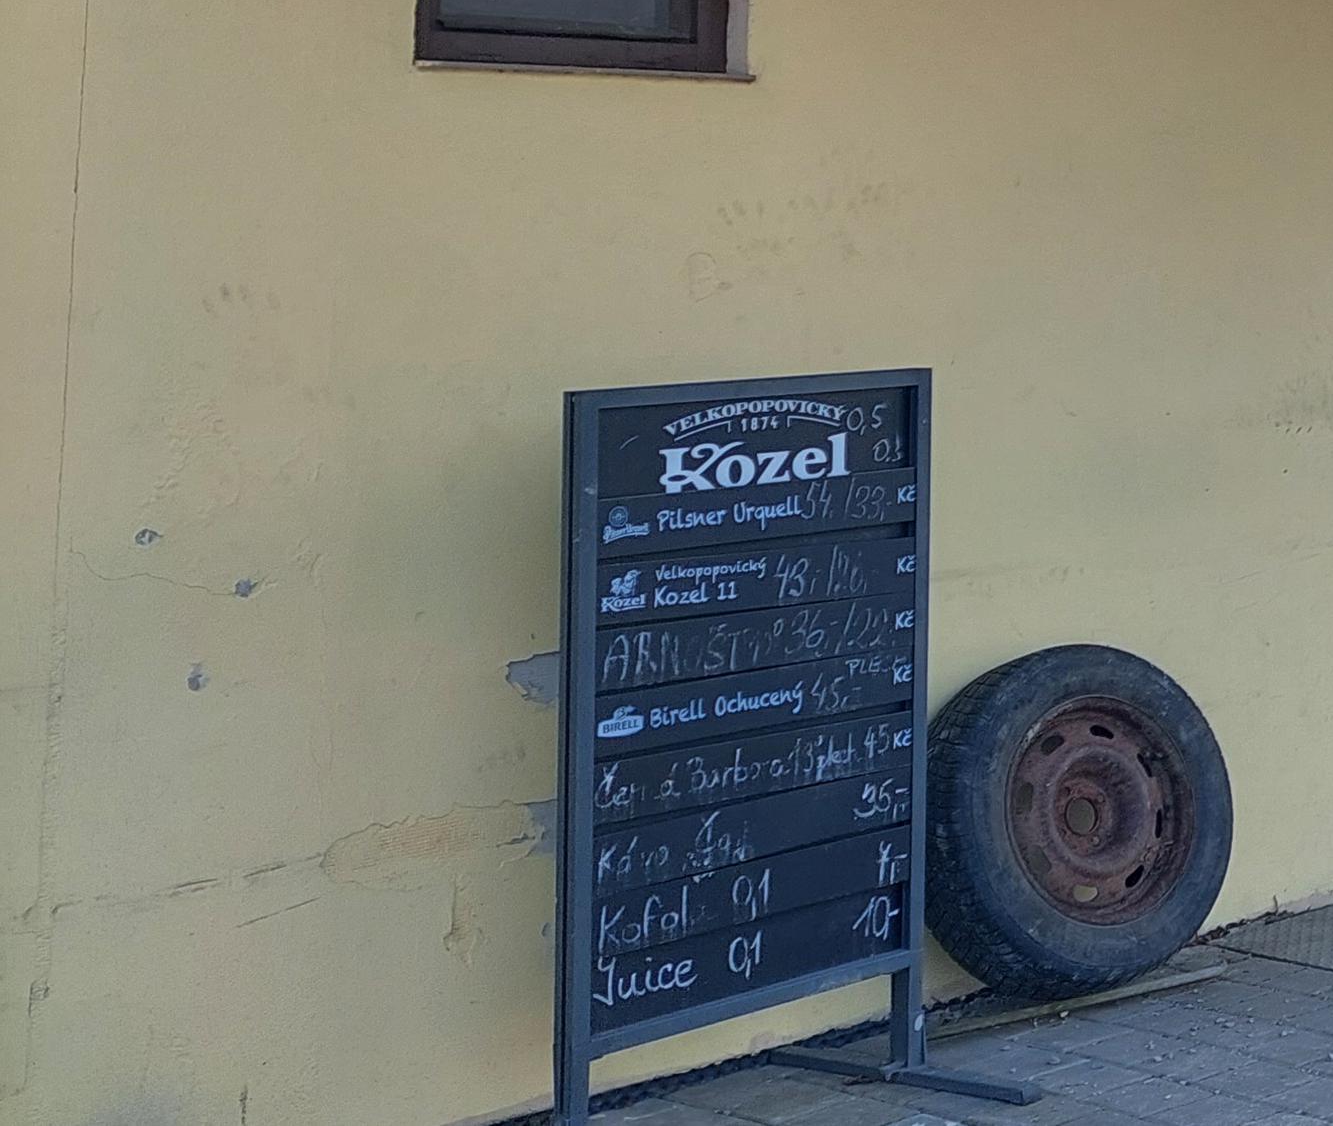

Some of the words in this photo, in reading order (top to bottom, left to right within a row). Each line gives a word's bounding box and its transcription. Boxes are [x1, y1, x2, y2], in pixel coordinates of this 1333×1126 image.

[662, 399, 847, 436] VELKOPOPOVICKÝ
[740, 415, 779, 432] 1874
[658, 431, 852, 494] Kozel
[897, 484, 917, 505] Kč
[656, 508, 729, 533] Pilsner
[732, 494, 803, 531] Urquell
[655, 556, 768, 585] Velkopopovický
[896, 554, 917, 575] Kč
[653, 582, 709, 609] Kozel
[716, 580, 739, 601] 11
[894, 610, 915, 630] Kč
[892, 662, 913, 687] Kč
[650, 698, 706, 728] Birell
[713, 680, 806, 717] Ochucený
[601, 717, 641, 735] BIRELL
[892, 728, 913, 747] Kč
[593, 957, 698, 1007] Juice
